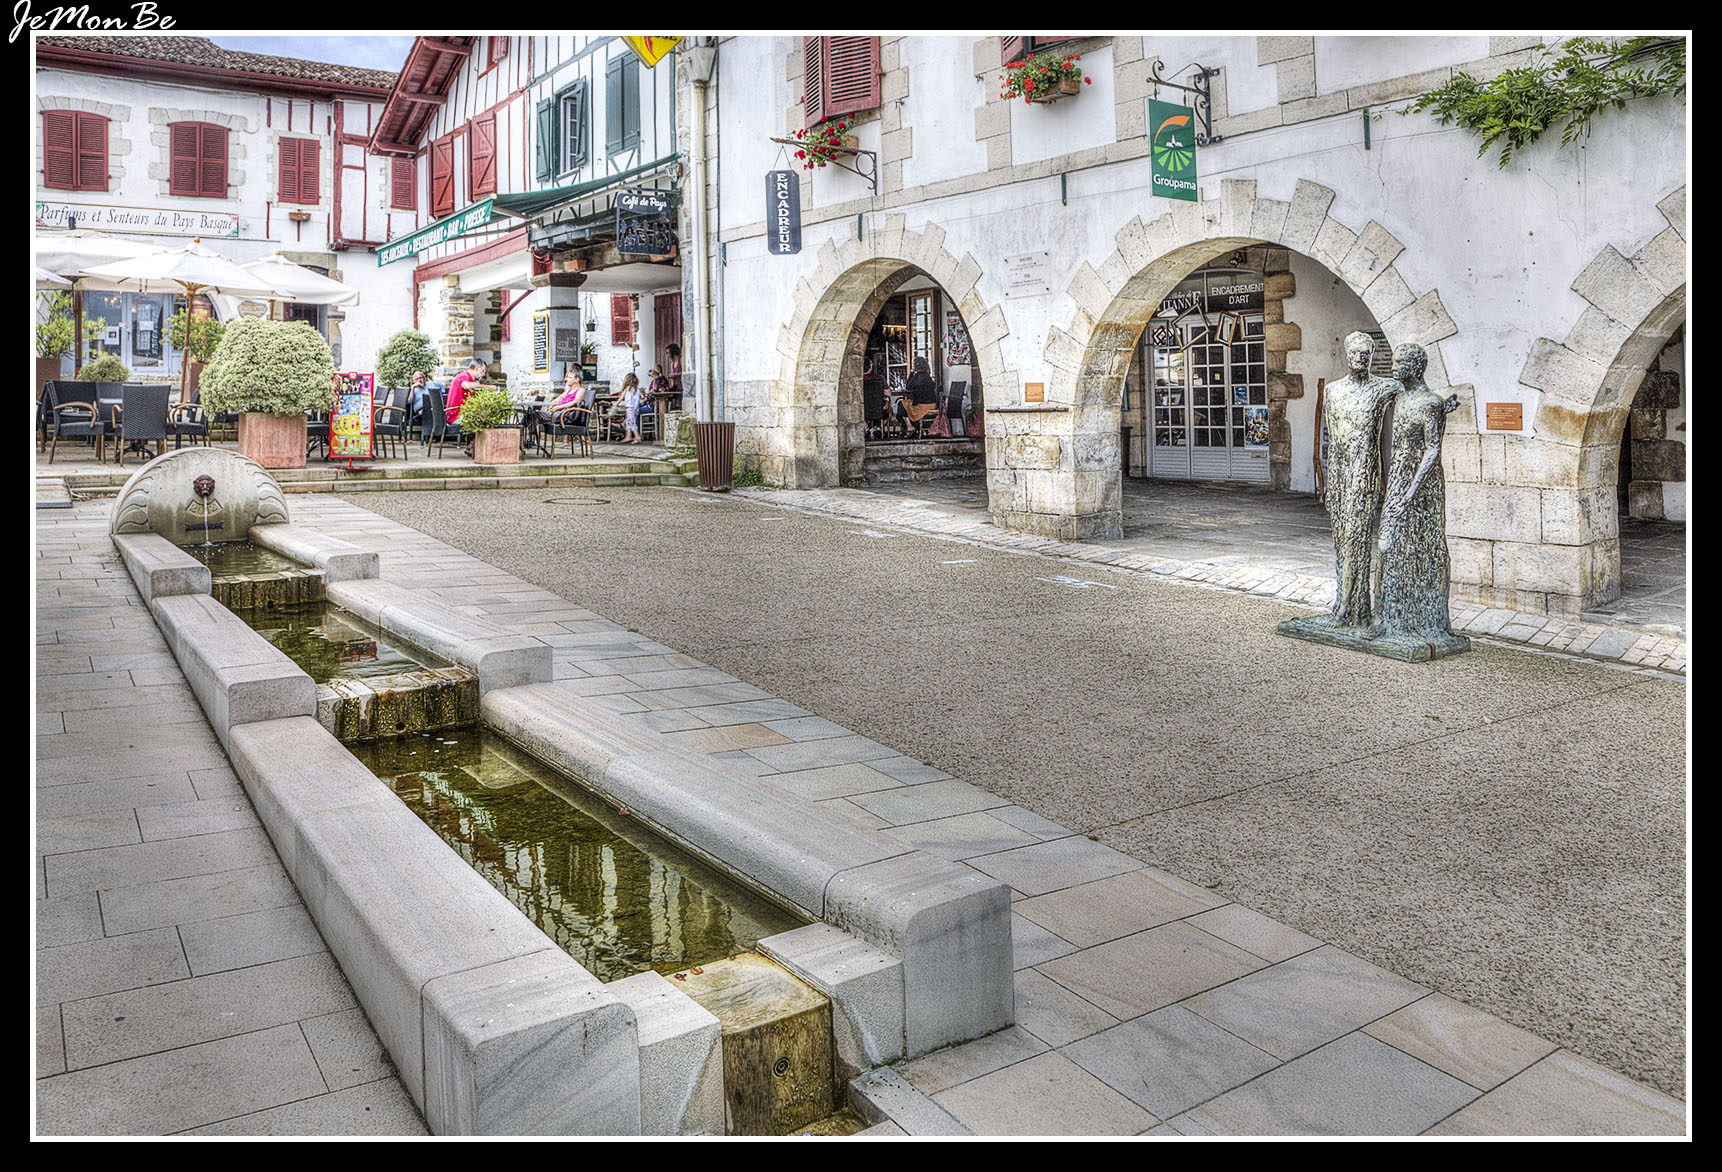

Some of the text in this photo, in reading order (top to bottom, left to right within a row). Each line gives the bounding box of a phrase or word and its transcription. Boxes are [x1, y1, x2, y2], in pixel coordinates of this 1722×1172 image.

[1153, 174, 1196, 190] Groupama
[622, 195, 667, 211] Café de Pays
[40, 204, 233, 234] Parfums et Senteurs du Pays Basque
[776, 173, 791, 252] ENCADREUR
[413, 226, 444, 253] RESTAURANT
[447, 219, 459, 237] BAR
[464, 206, 487, 230] PRESSE
[1211, 283, 1264, 296] ENCADREMENT
[1228, 294, 1250, 305] D'ART
